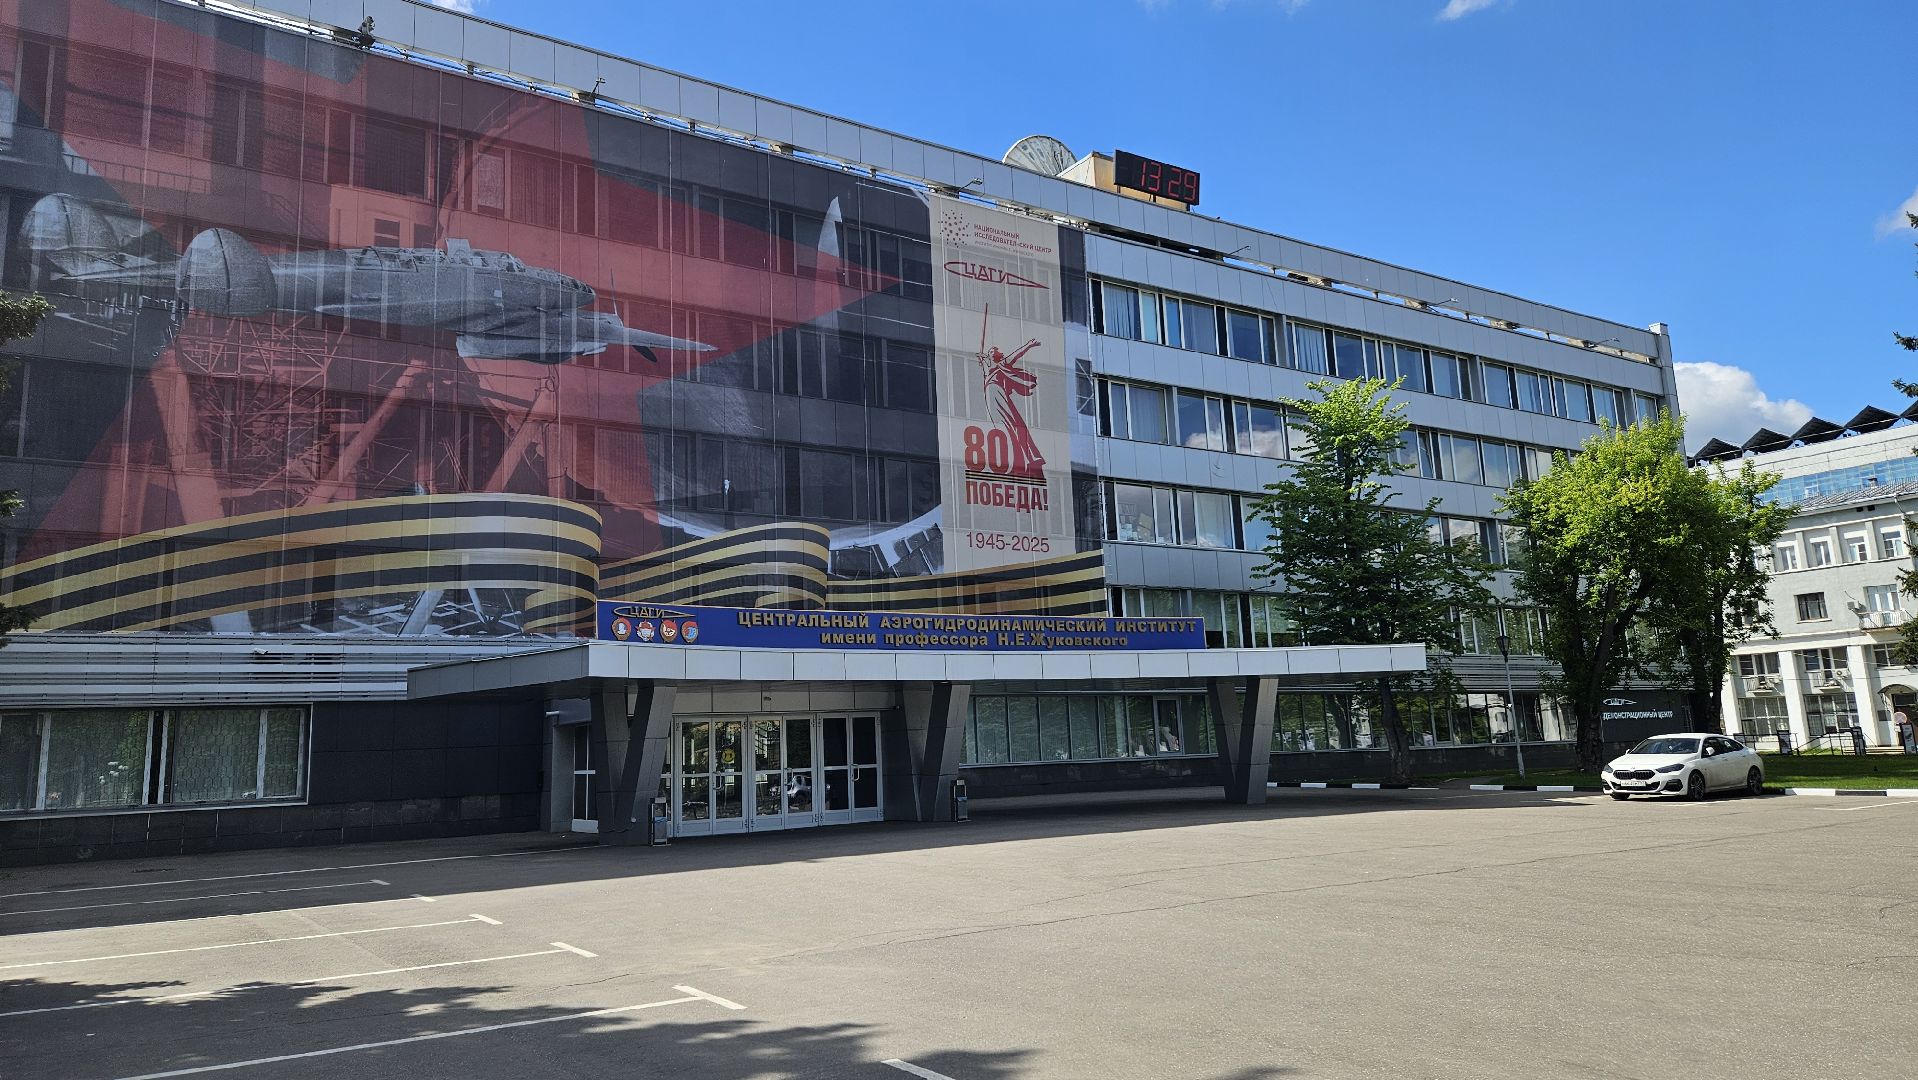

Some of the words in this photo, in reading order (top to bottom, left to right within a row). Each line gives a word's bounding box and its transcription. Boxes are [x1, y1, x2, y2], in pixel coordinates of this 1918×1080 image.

[1034, 246, 1052, 254] ЦЕНТР
[964, 426, 1009, 474] 80
[966, 481, 1049, 513] ПОБЕДА!
[967, 532, 1050, 552] 1945-2025
[738, 612, 869, 628] ЦЕНТРАЛЬНЫЙ
[880, 616, 1107, 632] АЭРОГИДРОДИНАМИЧЕСКИЙ
[1115, 620, 1197, 632] ИНСТИТУТ
[821, 632, 877, 644] имени
[885, 632, 988, 648] профессора
[997, 633, 1129, 648] Н.Е.Жуковского
